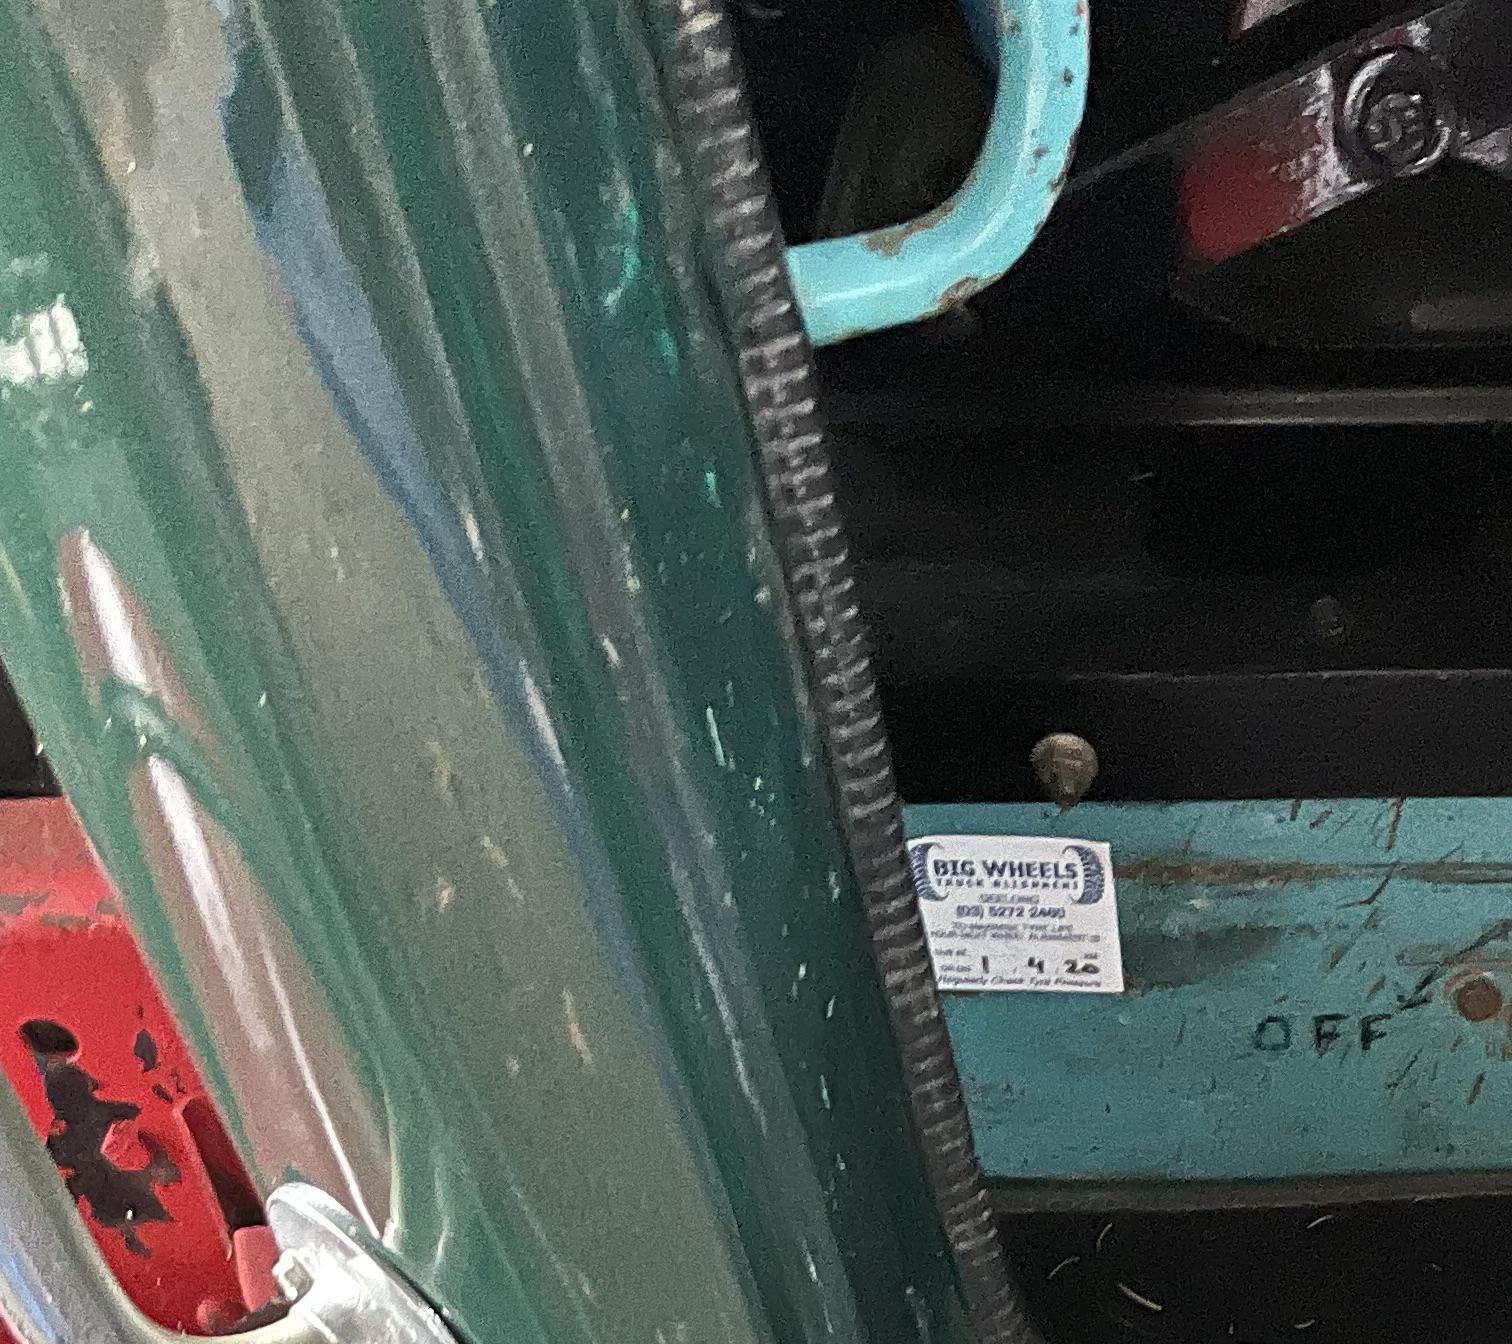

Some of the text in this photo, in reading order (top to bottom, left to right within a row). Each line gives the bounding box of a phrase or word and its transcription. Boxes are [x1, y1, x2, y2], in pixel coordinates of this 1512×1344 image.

[933, 860, 1078, 878] BIG WHEELS
[937, 879, 1078, 890] TRUCK ALIGNMENT
[1253, 1013, 1392, 1052] OFF
